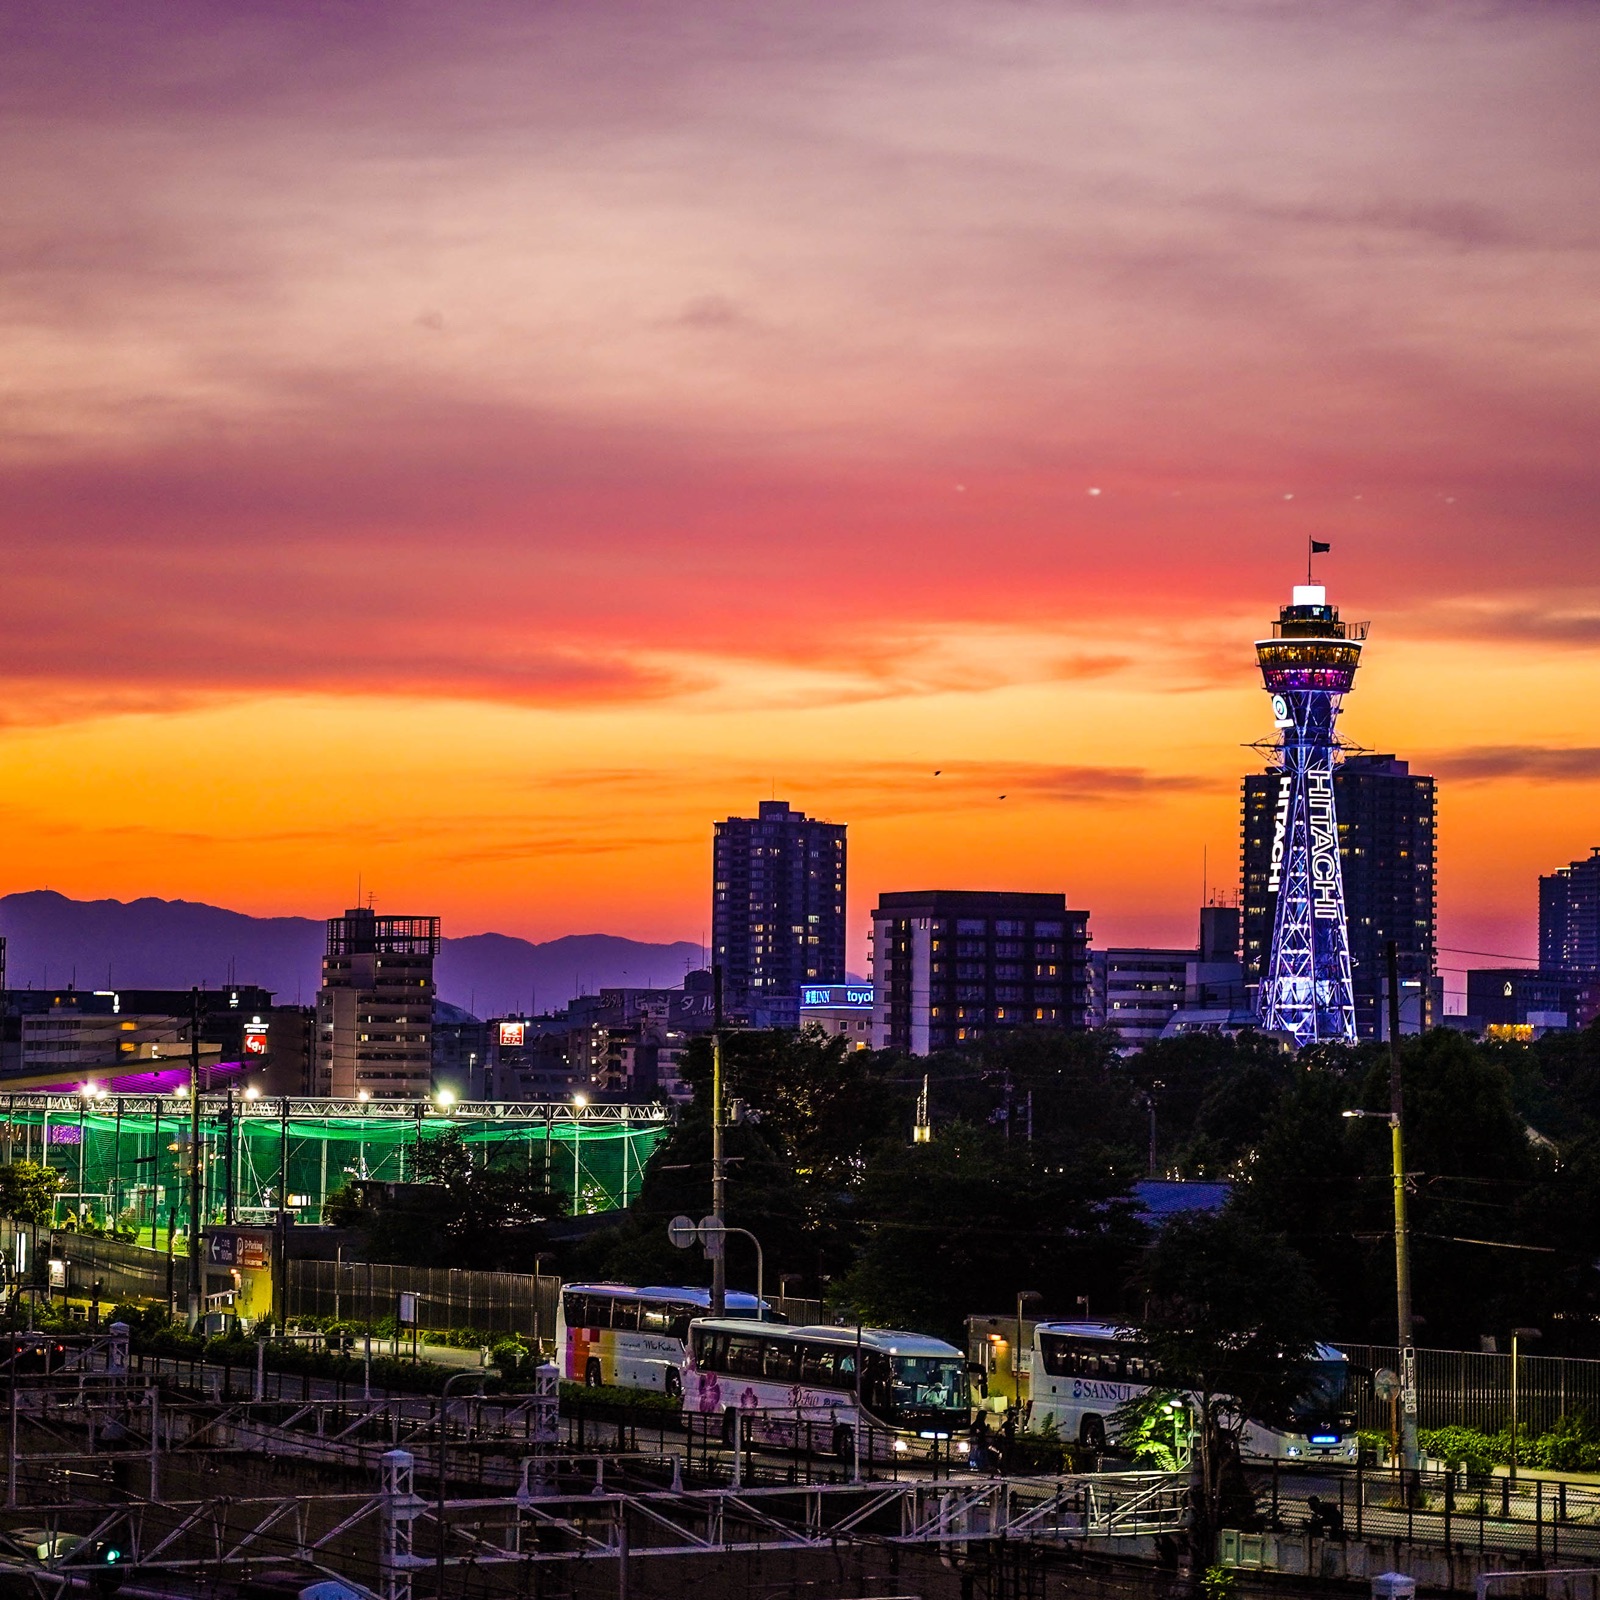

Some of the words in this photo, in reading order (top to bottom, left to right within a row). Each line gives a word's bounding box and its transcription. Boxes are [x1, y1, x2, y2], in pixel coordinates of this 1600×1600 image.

[1268, 777, 1291, 892] HITACHI
[1308, 770, 1338, 919] HITACHI
[38, 1145, 61, 1153] GRDEN
[1083, 1381, 1131, 1401] SANSUI
